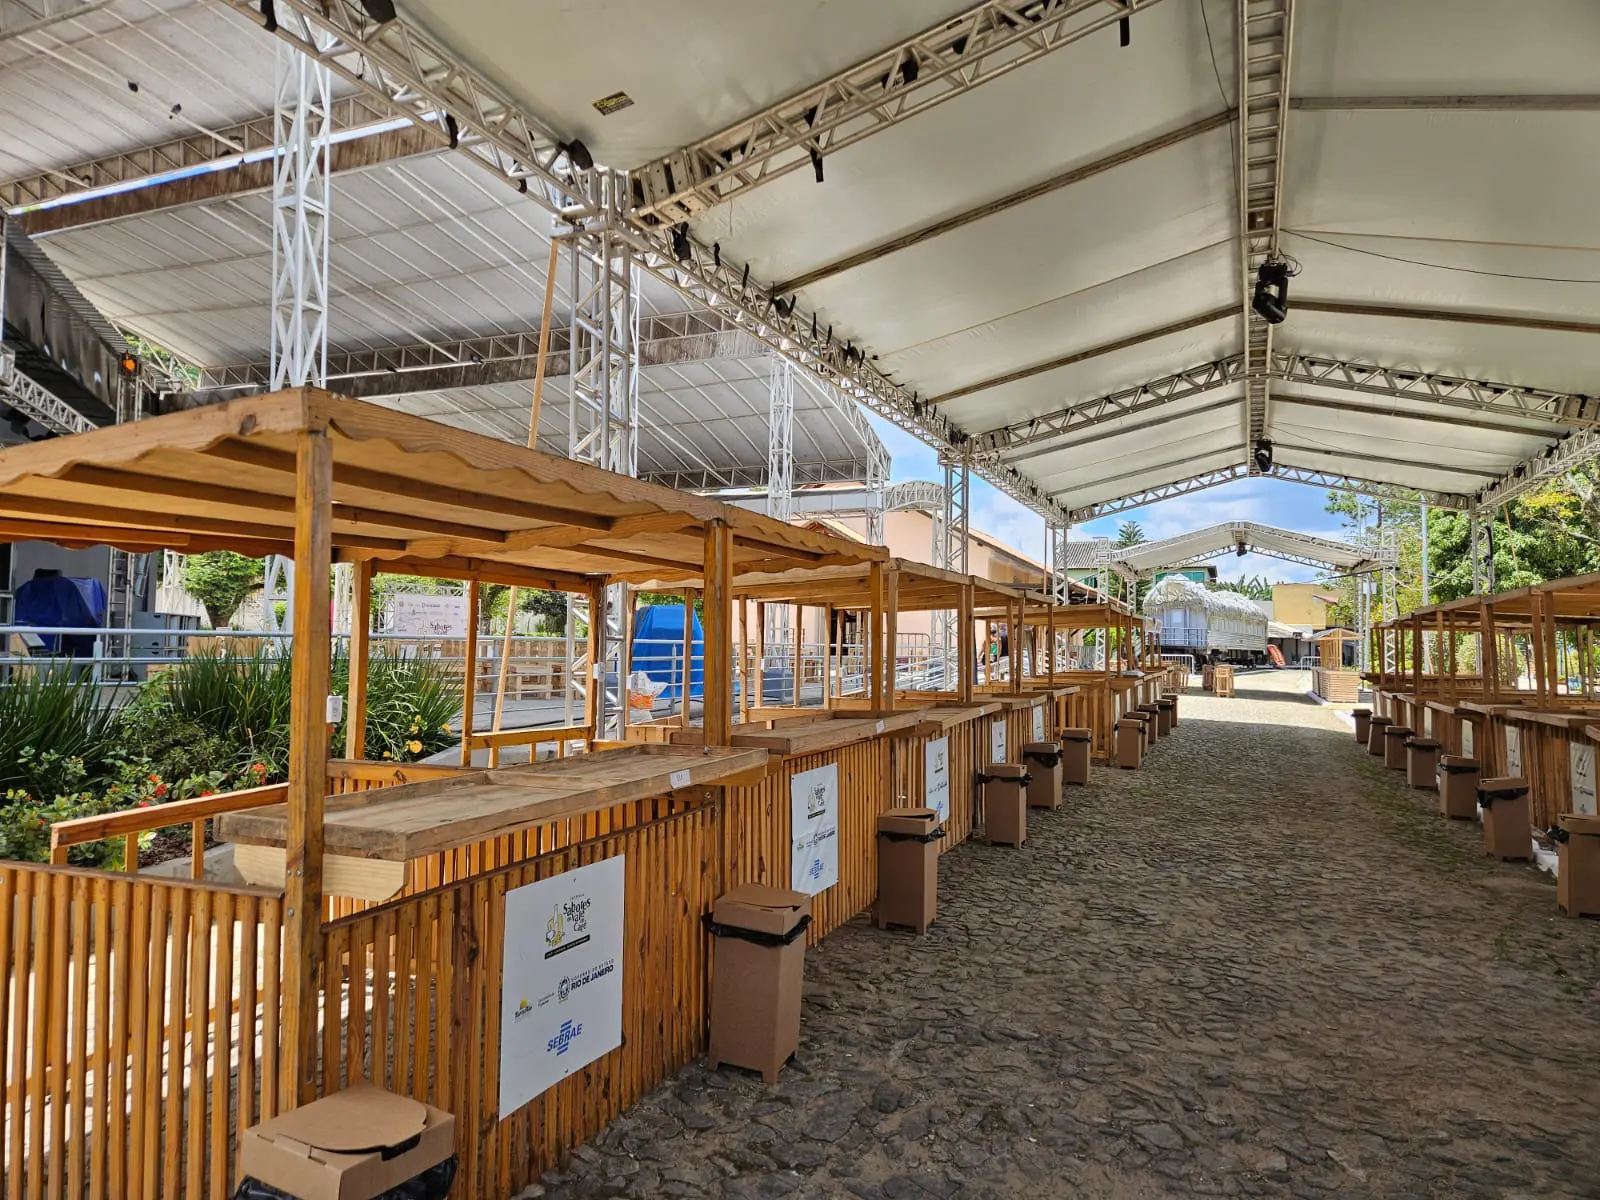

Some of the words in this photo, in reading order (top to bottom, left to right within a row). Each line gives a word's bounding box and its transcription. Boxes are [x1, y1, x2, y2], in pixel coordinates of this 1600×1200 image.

[563, 898, 591, 917] Sabores
[571, 980, 582, 991] RIO
[582, 975, 591, 986] DE
[590, 964, 614, 982] JANEIRO
[547, 1023, 582, 1052] SEBRAE
